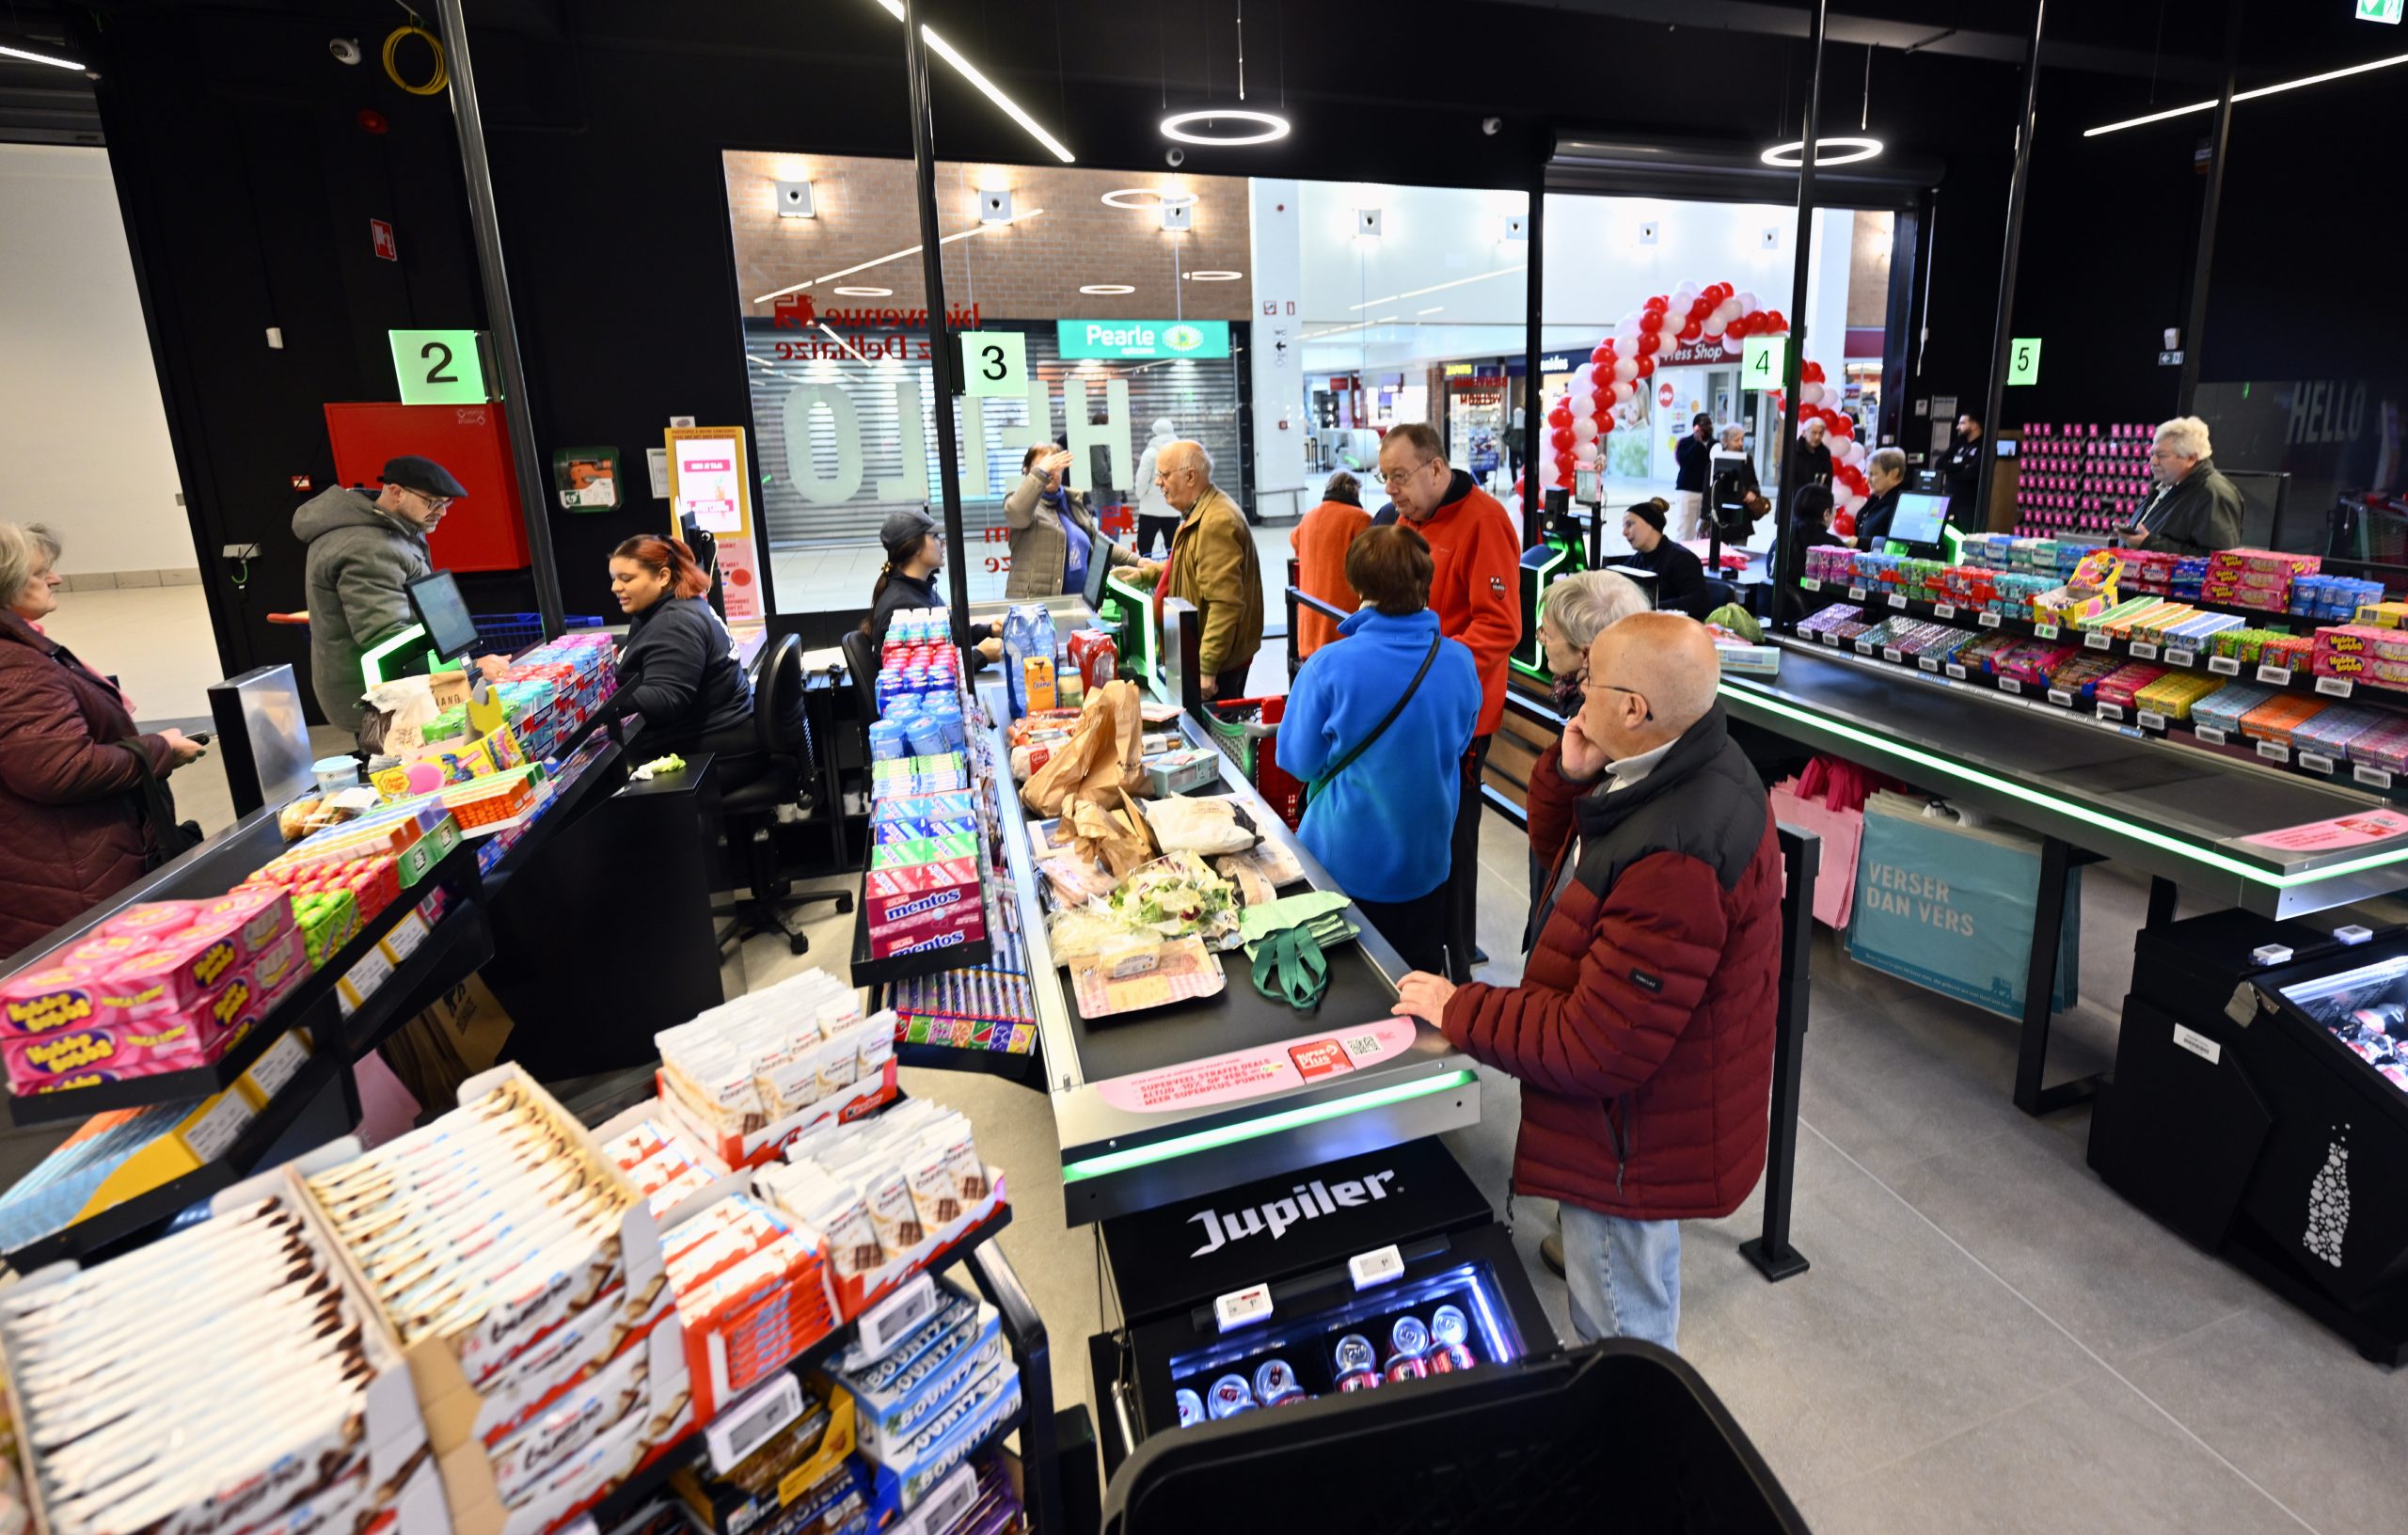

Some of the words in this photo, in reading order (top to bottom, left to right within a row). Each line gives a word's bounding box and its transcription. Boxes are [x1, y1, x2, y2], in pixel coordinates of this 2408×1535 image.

[1086, 324, 1156, 346] Pearle
[1695, 344, 1724, 361] Shop
[420, 341, 459, 384] 2
[981, 345, 1007, 380] 3
[1755, 350, 1770, 374] 4
[2018, 347, 2030, 371] 5
[2285, 380, 2368, 445] HELLO
[1869, 860, 1950, 903] VERSER
[887, 888, 961, 922] mentos
[1866, 887, 1910, 918] DAN
[1918, 900, 1974, 937] VERS
[1140, 1075, 1195, 1093] SUPERVEEL
[1241, 1057, 1271, 1069] DEALS
[1224, 1069, 1248, 1081] VERS
[1144, 1094, 1171, 1106] MEER
[1186, 1169, 1395, 1258] Jupiler
[865, 1320, 941, 1387] BOUNTY
[900, 1354, 977, 1427] BOUNTY
[919, 1416, 996, 1491] BOUNTY
